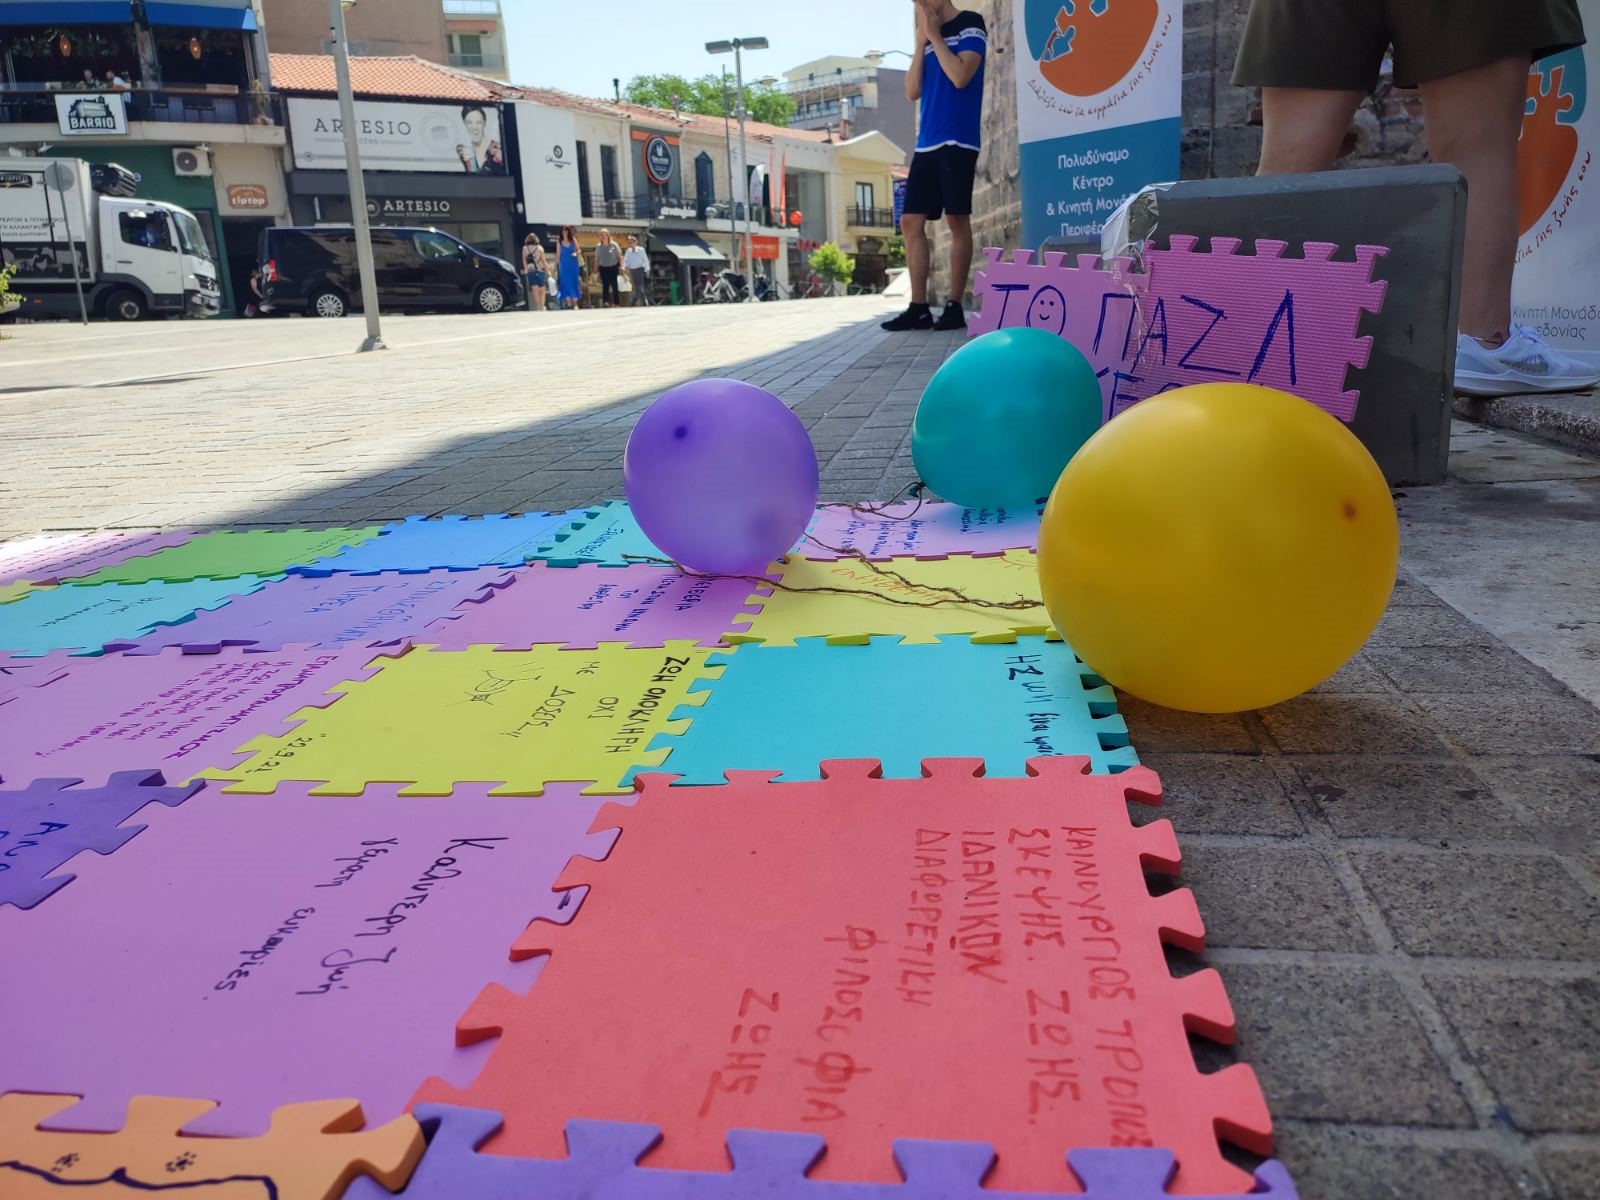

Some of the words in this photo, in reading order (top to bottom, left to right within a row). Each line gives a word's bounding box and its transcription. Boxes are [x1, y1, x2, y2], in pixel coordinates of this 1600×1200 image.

[314, 118, 411, 136] ARESIO
[1058, 149, 1129, 169] Πολυδύναμο
[1072, 176, 1114, 192] Κέντρο
[383, 199, 450, 211] ARTESIO
[1046, 202, 1055, 216] &
[1058, 198, 1093, 215] Κινητή
[1096, 194, 1132, 211] Μονά
[1092, 289, 1297, 387] ΠΑΖΛ
[587, 696, 619, 720] ΟΧΙ
[605, 687, 666, 753] ΟΛΟΚΛΗΡΗ
[1061, 826, 1136, 1002] ΚΑΙΝΟΥΡΓΙΟΣ
[794, 924, 888, 1124] ΦΙΛΟΣΟΦΙΑ
